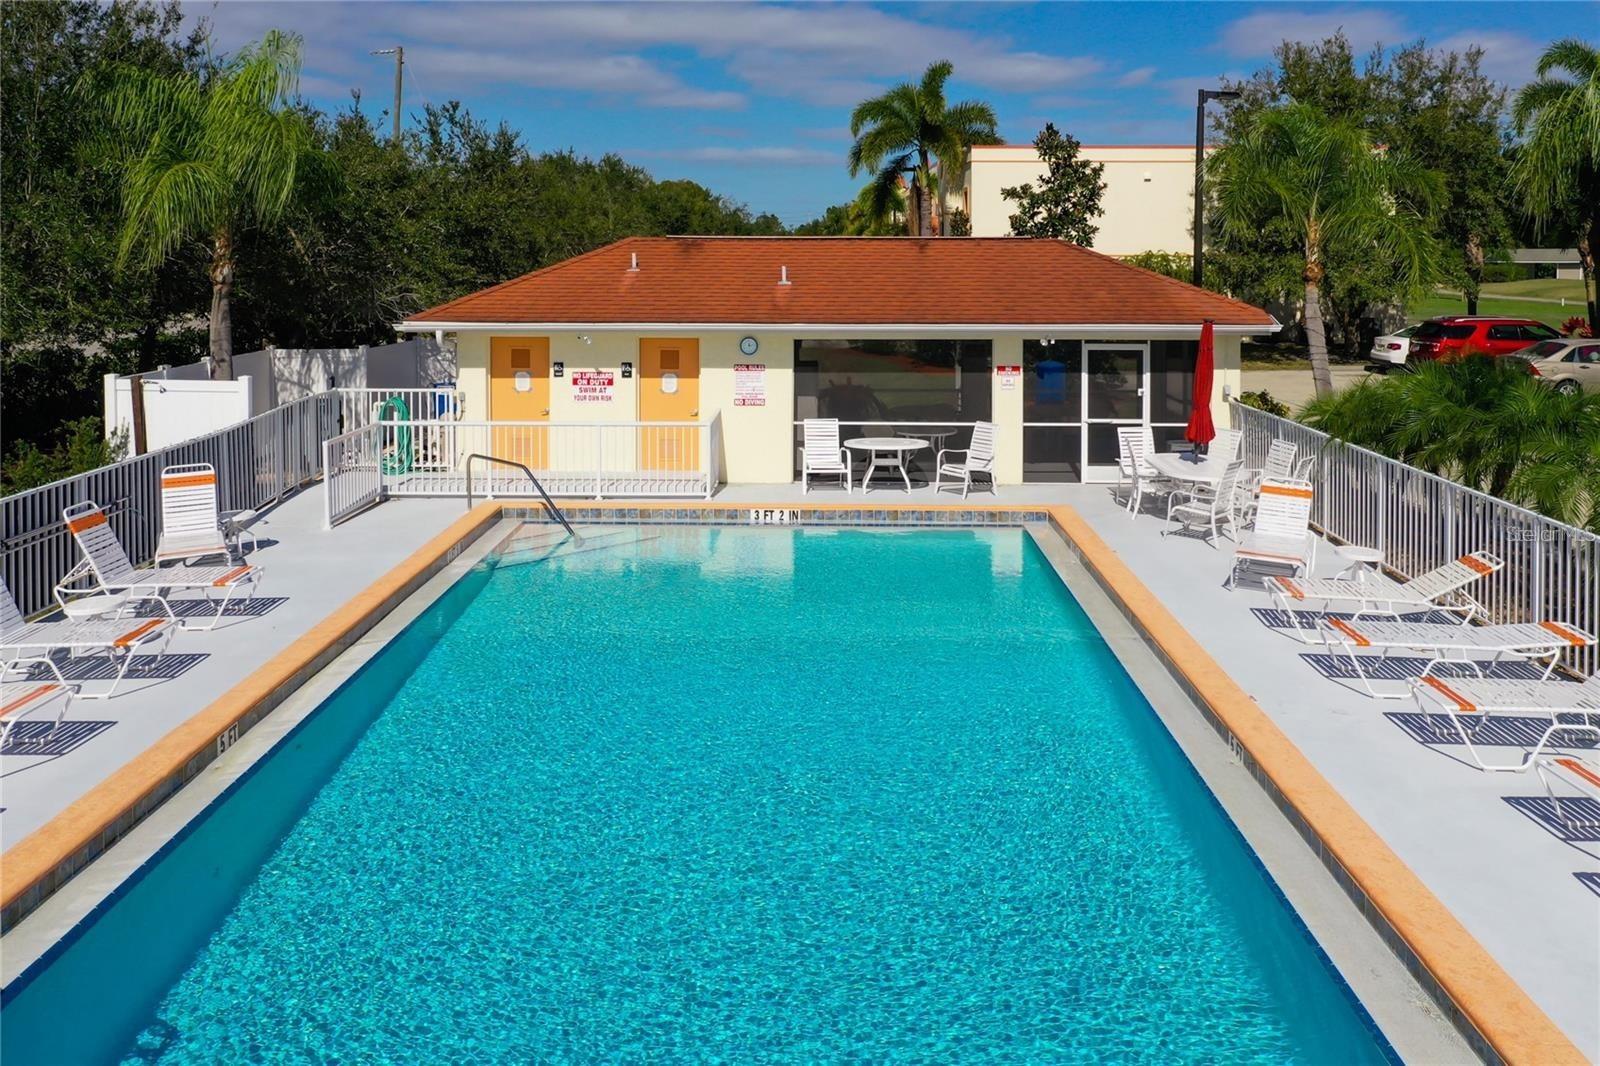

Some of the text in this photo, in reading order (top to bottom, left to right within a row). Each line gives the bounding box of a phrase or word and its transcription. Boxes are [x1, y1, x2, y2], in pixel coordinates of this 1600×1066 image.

[754, 510, 799, 521] 3 FT 2 IN
[220, 723, 238, 753] 5 FT
